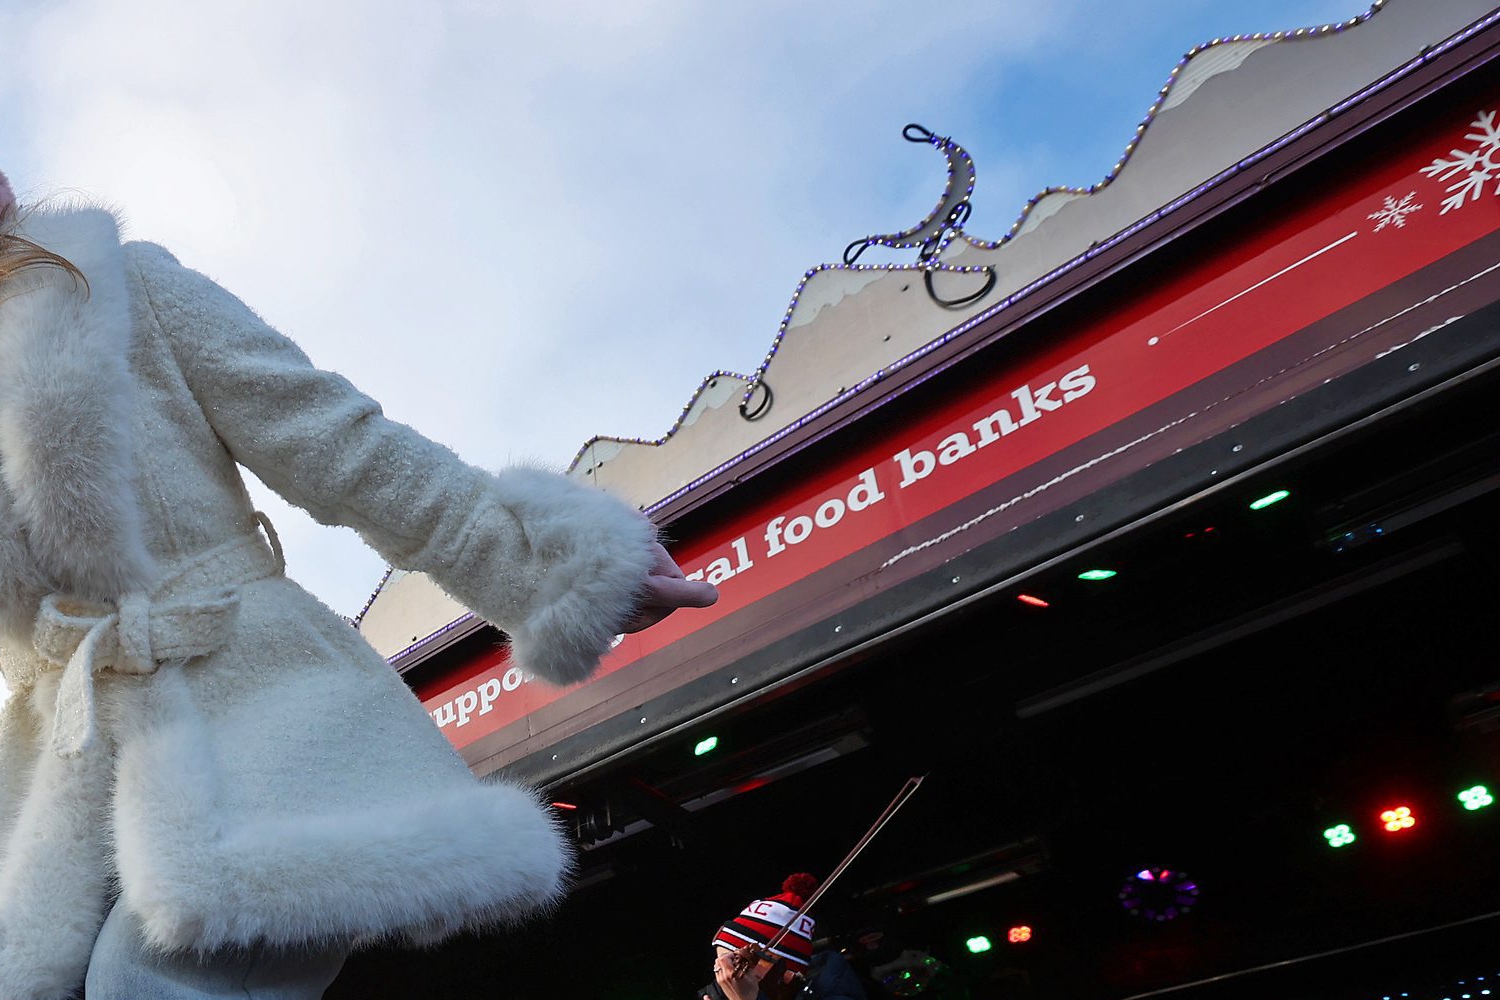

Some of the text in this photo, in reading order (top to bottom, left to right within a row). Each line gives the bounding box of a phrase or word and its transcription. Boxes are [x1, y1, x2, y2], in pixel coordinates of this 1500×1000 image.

[429, 667, 534, 727] uppo
[764, 467, 885, 558] food
[894, 364, 1097, 488] banks
